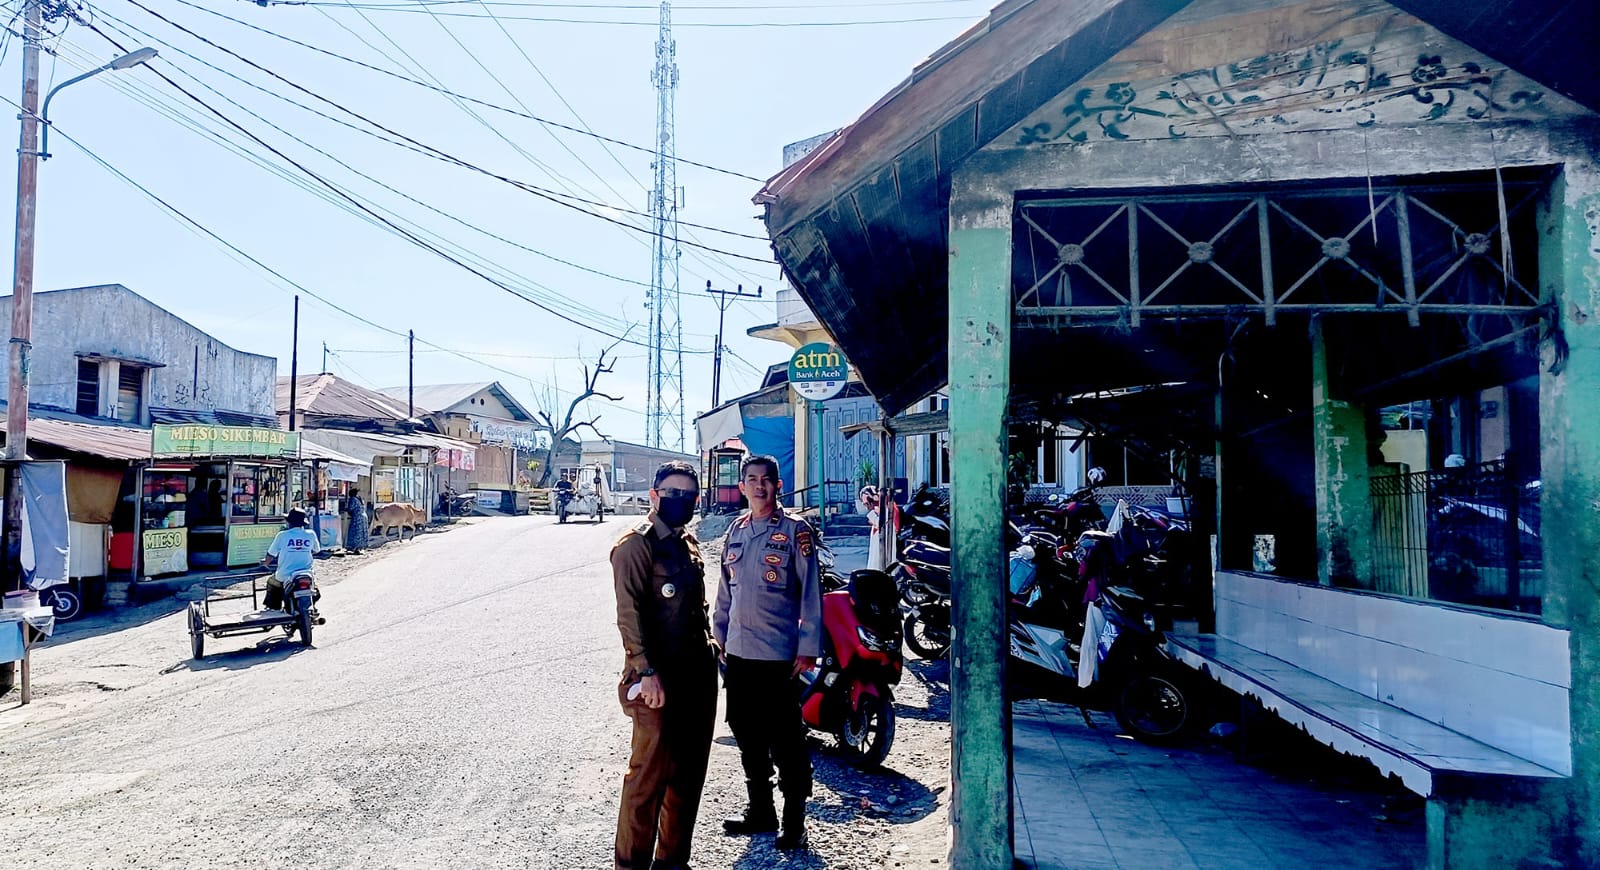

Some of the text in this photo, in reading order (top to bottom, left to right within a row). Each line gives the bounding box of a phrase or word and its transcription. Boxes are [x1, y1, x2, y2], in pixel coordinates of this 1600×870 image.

[794, 349, 840, 368] atm
[795, 370, 840, 379] Bank Aceh
[171, 426, 287, 444] MIESO SIKEMBAR
[144, 531, 182, 550] MIESO
[287, 538, 310, 547] ABC
